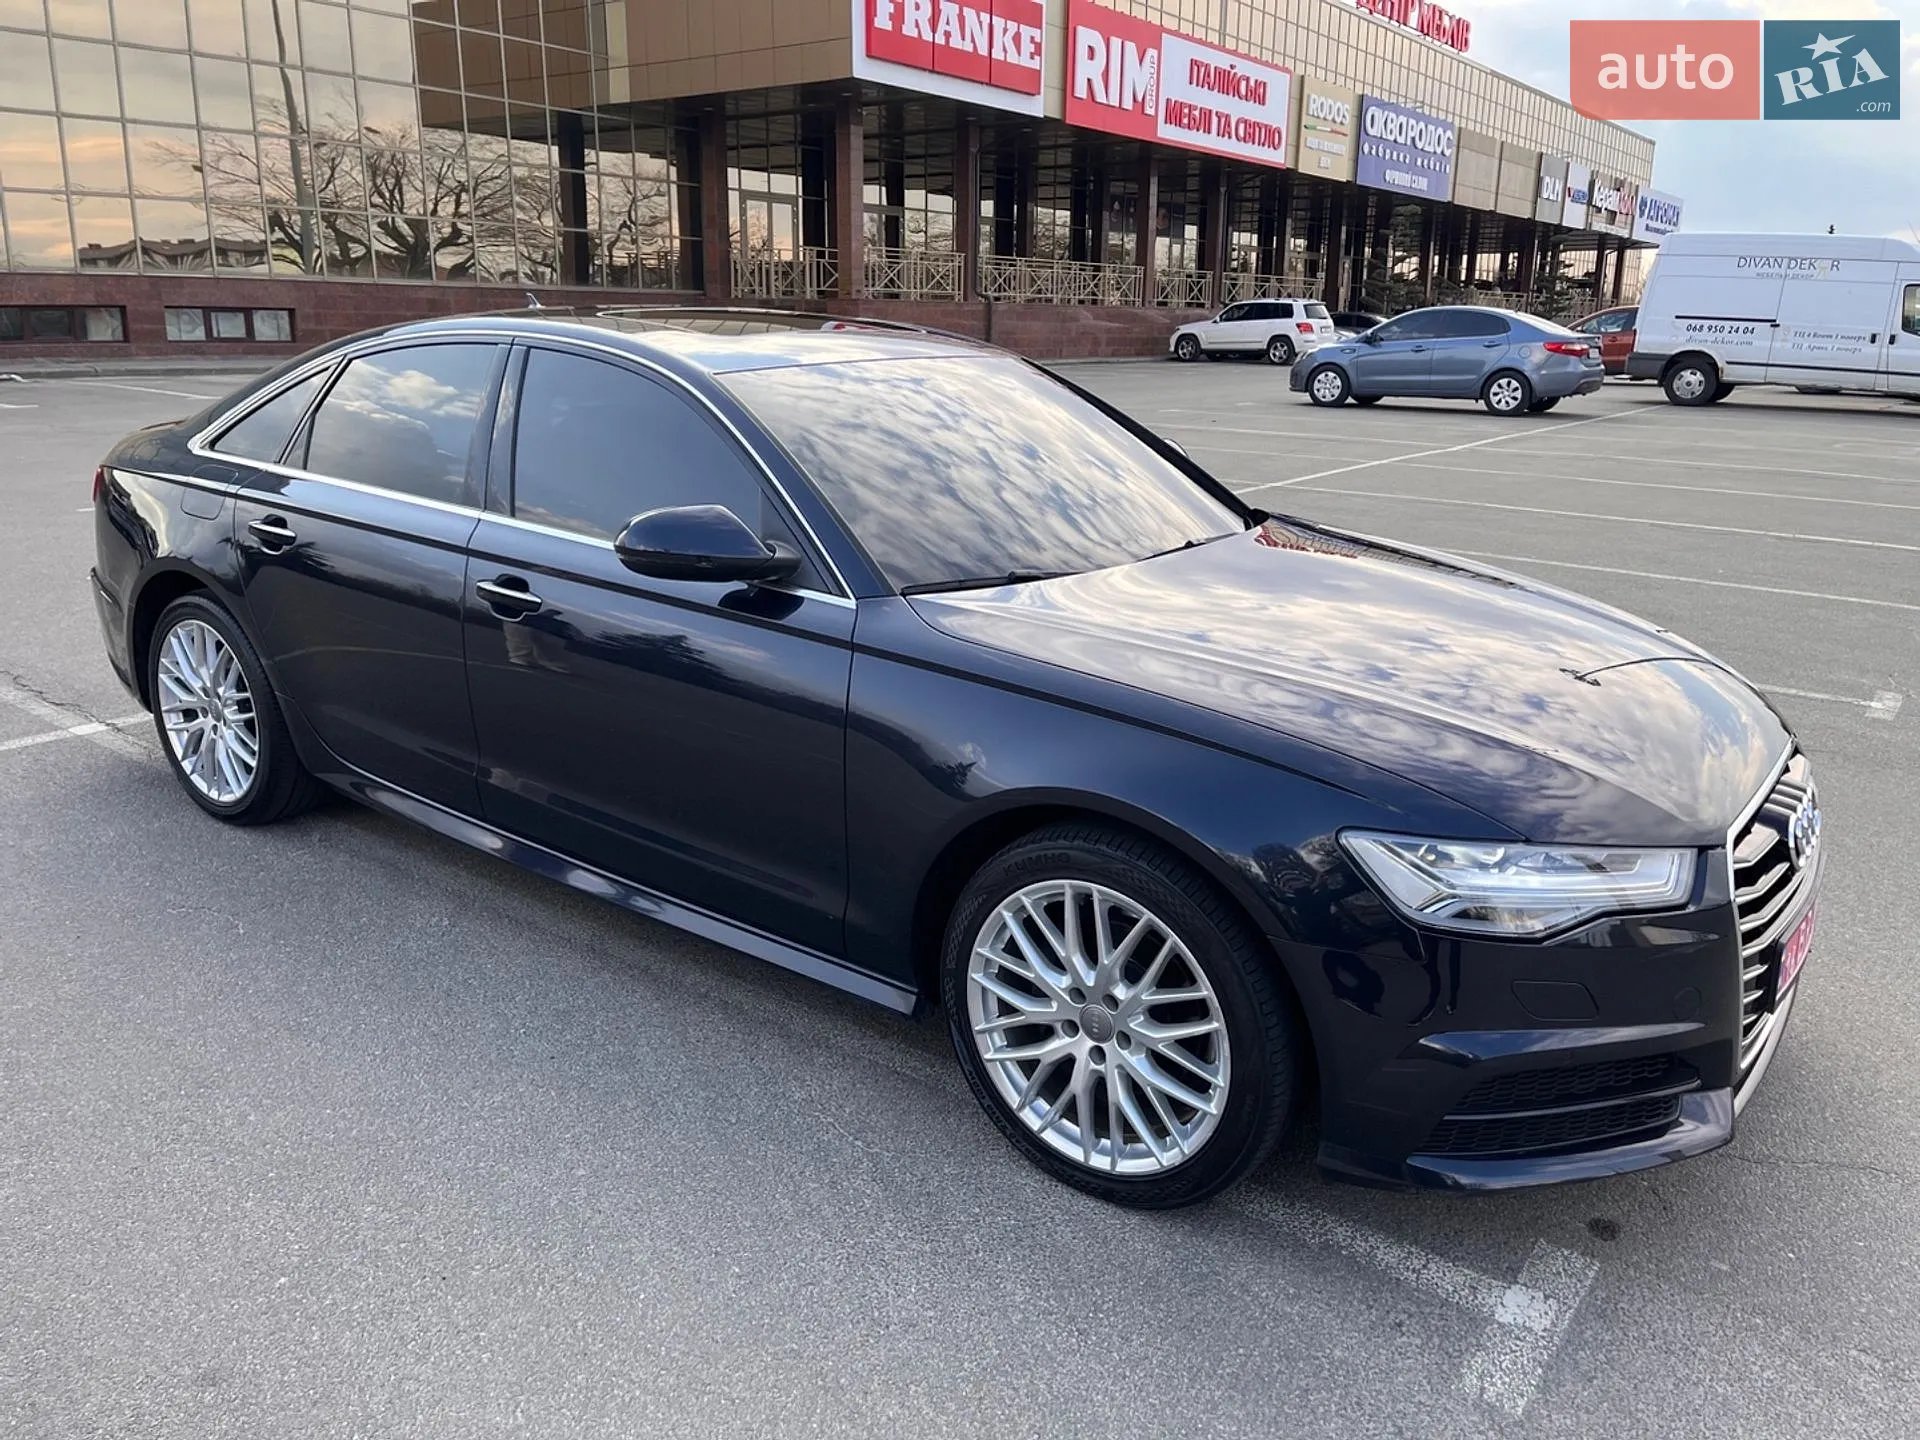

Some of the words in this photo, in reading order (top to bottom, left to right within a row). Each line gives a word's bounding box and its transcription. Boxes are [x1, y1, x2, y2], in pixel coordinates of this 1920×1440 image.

[874, 0, 1041, 70] FRANKE
[1074, 25, 1158, 116] RIM
[1148, 54, 1158, 110] GROUP
[1188, 57, 1268, 107] ІТАЛІЙСЬКІ
[1164, 98, 1213, 135] МЕБЛІ
[1215, 109, 1232, 140] ТА
[1234, 116, 1283, 151] СВІТЛО
[1306, 93, 1350, 125] RODOS
[1737, 256, 1783, 268] DIVAN
[1686, 323, 1704, 333] 068
[1707, 324, 1725, 334] 950
[1728, 326, 1740, 335] 24
[1742, 326, 1755, 335] 04
